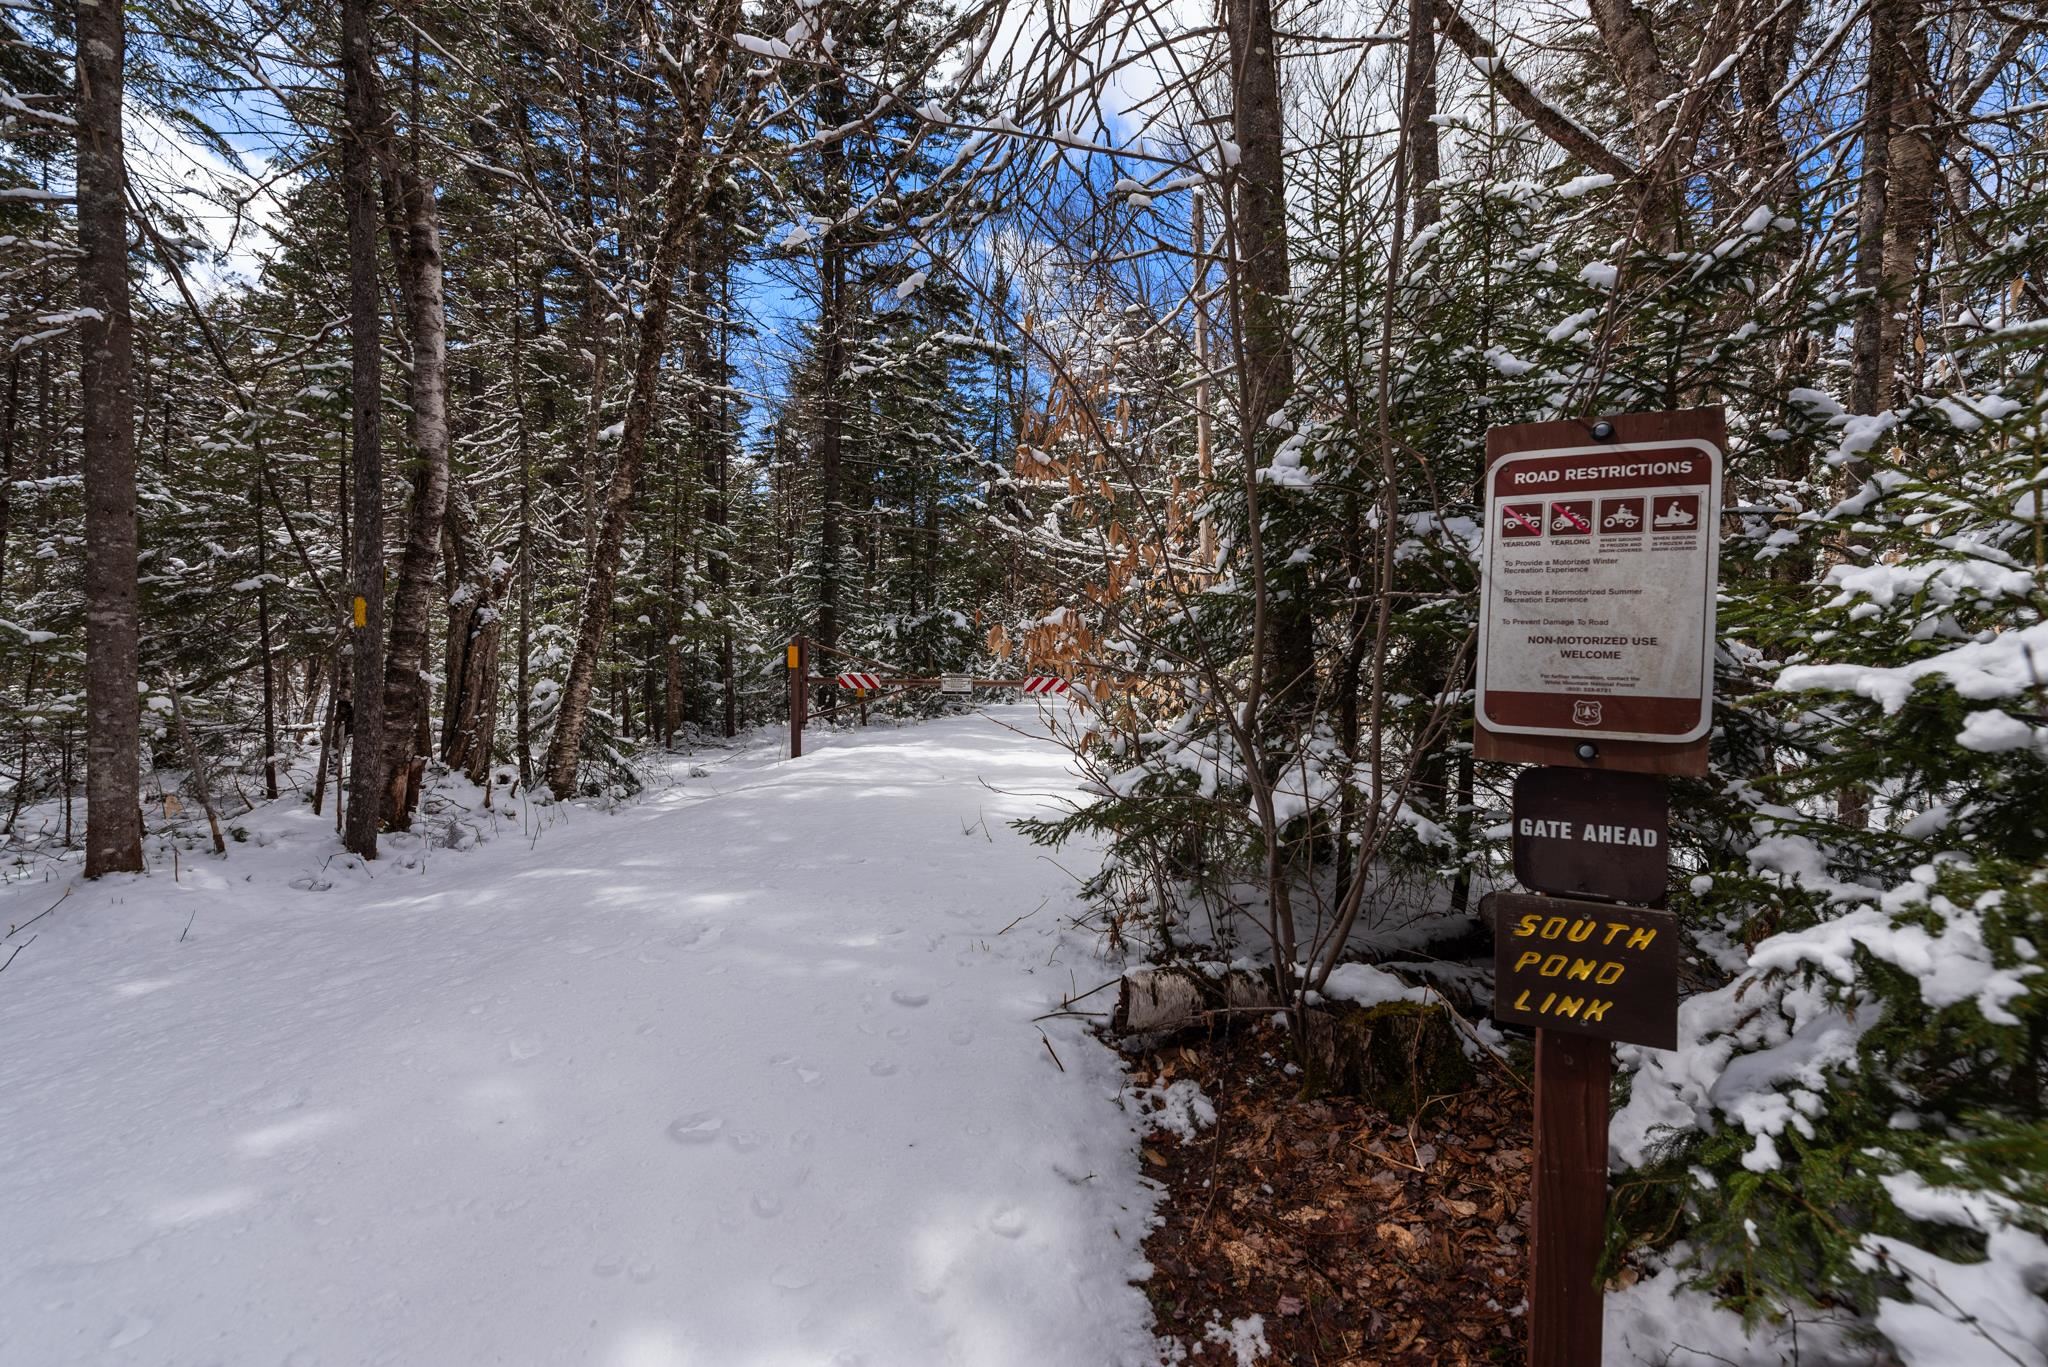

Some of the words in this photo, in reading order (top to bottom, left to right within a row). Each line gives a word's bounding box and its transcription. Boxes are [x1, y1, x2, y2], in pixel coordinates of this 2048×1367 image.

[1514, 470, 1560, 484] ROAD
[1565, 461, 1693, 481] RESTRICTIONS
[1502, 540, 1541, 548] YEARLONG
[1550, 538, 1591, 546] YEARLONG
[1592, 557, 1619, 565] Winter
[1546, 566, 1589, 574] Experience
[1545, 596, 1588, 604] Experience
[1543, 618, 1575, 626] Damage
[1527, 636, 1628, 645] NON-MOTORIZED
[1632, 637, 1658, 646] USE
[1560, 650, 1621, 659] WELCOME
[1519, 817, 1573, 840] GATE
[1582, 822, 1658, 848] AHEAD
[1513, 913, 1657, 951] SOUTH
[1513, 951, 1625, 985] POND
[1513, 989, 1614, 1022] LINK
